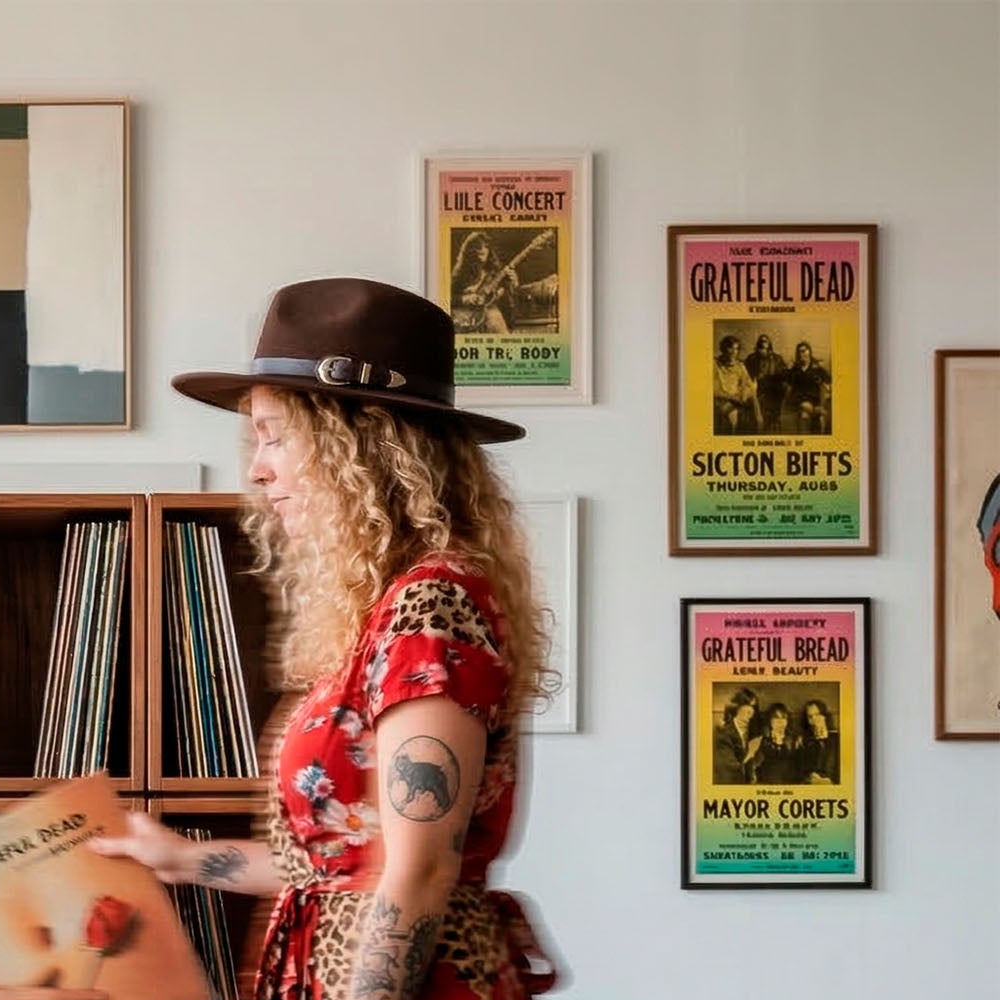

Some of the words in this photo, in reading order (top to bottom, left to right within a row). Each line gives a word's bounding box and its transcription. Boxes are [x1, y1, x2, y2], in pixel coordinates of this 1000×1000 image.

[492, 191, 566, 211] CONCERT
[690, 261, 794, 303] GRATEFUL
[801, 261, 855, 303] DEAD
[454, 347, 480, 360] OR
[692, 451, 775, 477] SICTON
[786, 451, 853, 477] BIFTS
[701, 637, 787, 663] GRATEFUL
[795, 637, 849, 662] BREAD
[703, 799, 770, 819] MAYOR
[778, 799, 849, 819] CORETS
